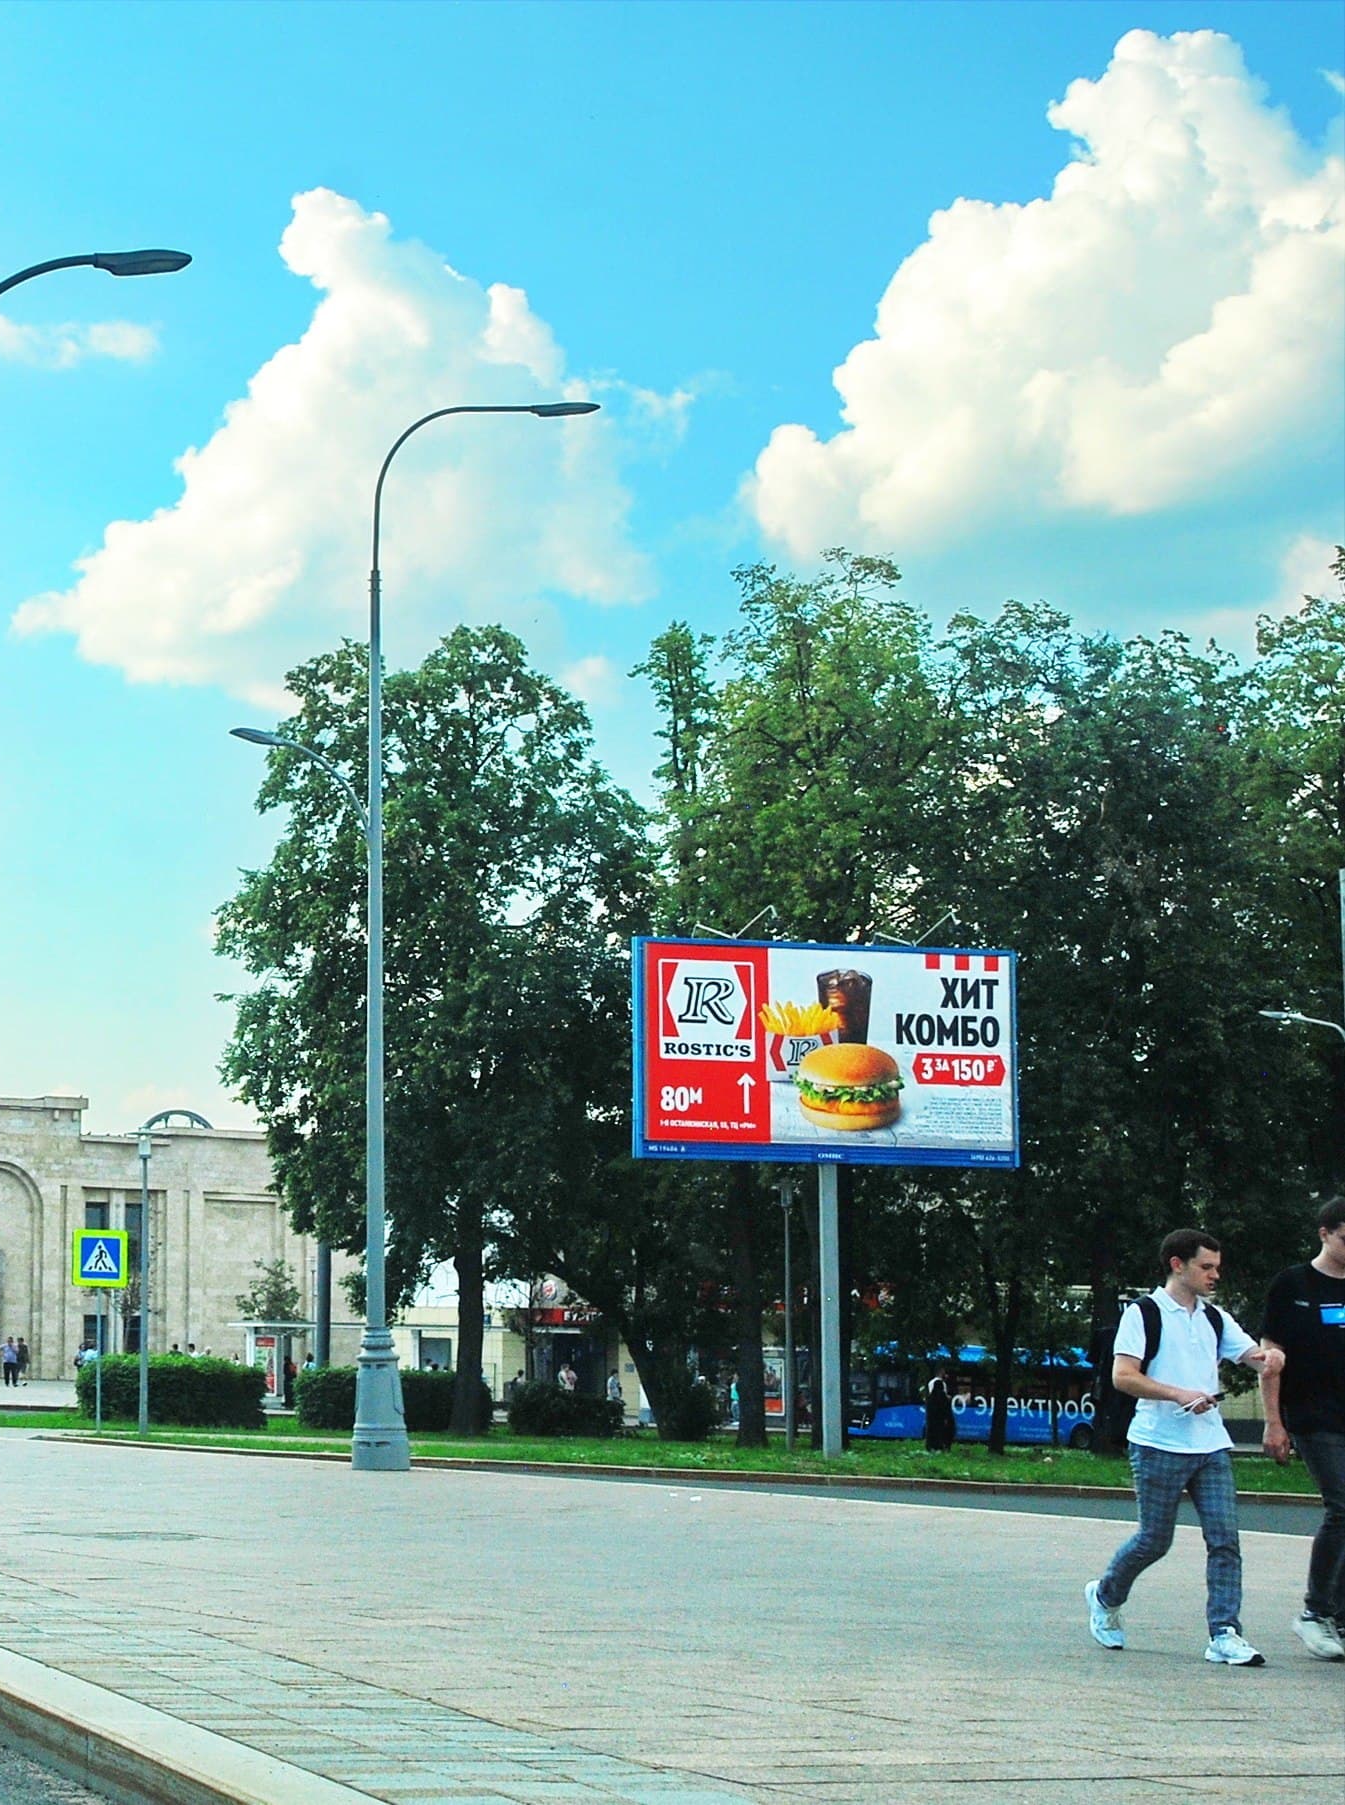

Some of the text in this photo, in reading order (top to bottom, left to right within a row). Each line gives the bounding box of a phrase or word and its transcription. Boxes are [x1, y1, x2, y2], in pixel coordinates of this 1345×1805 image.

[940, 977, 999, 1010] ХИТ
[895, 1013, 1000, 1048] КОМБО
[663, 1042, 752, 1058] ROSTIC'S
